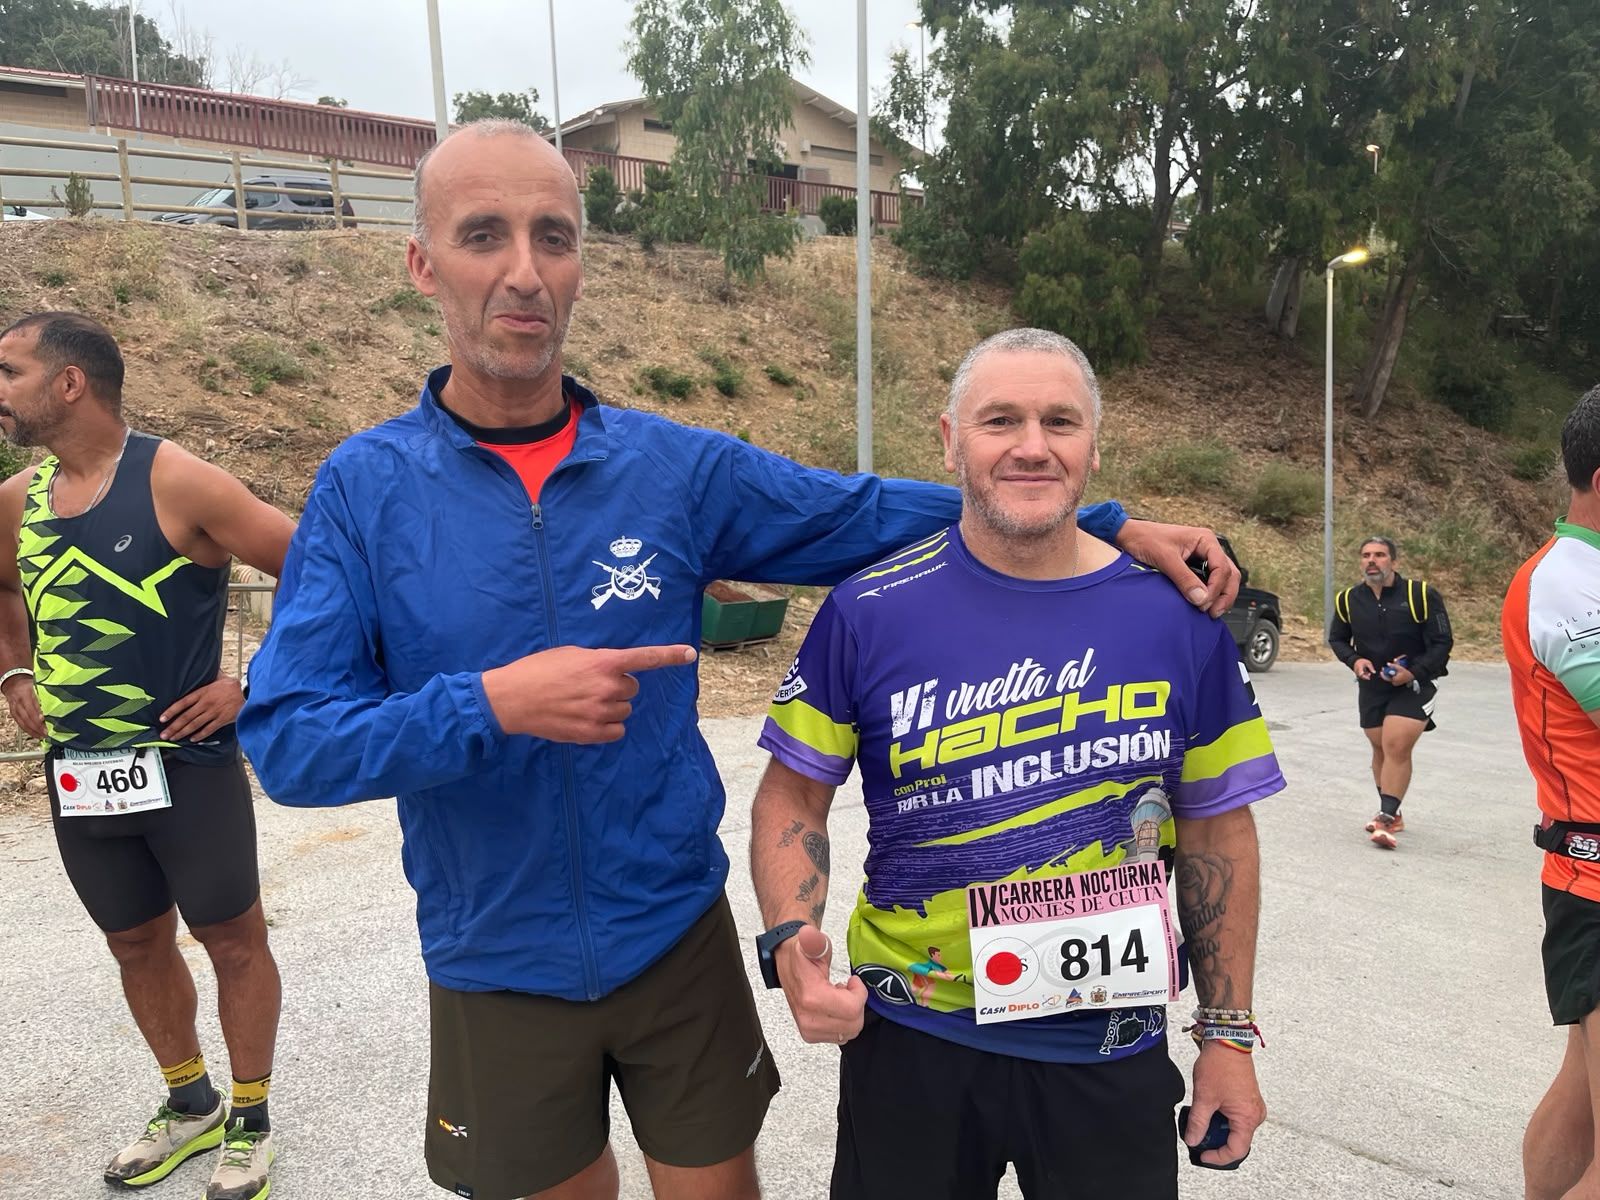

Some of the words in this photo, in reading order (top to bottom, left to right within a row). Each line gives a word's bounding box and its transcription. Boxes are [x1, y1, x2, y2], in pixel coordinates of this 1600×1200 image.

[945, 657, 1054, 720] vuelta
[1056, 647, 1097, 694] al
[97, 765, 148, 794] 460
[931, 787, 964, 806] LA
[971, 724, 1171, 800] INCLUSIÓN
[969, 885, 1001, 928] IX
[999, 877, 1075, 907] CARRERA
[1080, 862, 1162, 896] NOCTURNA
[1000, 899, 1076, 923] MONTES
[1083, 895, 1103, 913] DE
[1111, 885, 1164, 907] CEUTA
[1060, 928, 1150, 982] 814
[979, 1006, 1006, 1016] CASH
[1008, 1002, 1040, 1013] DIPLO
